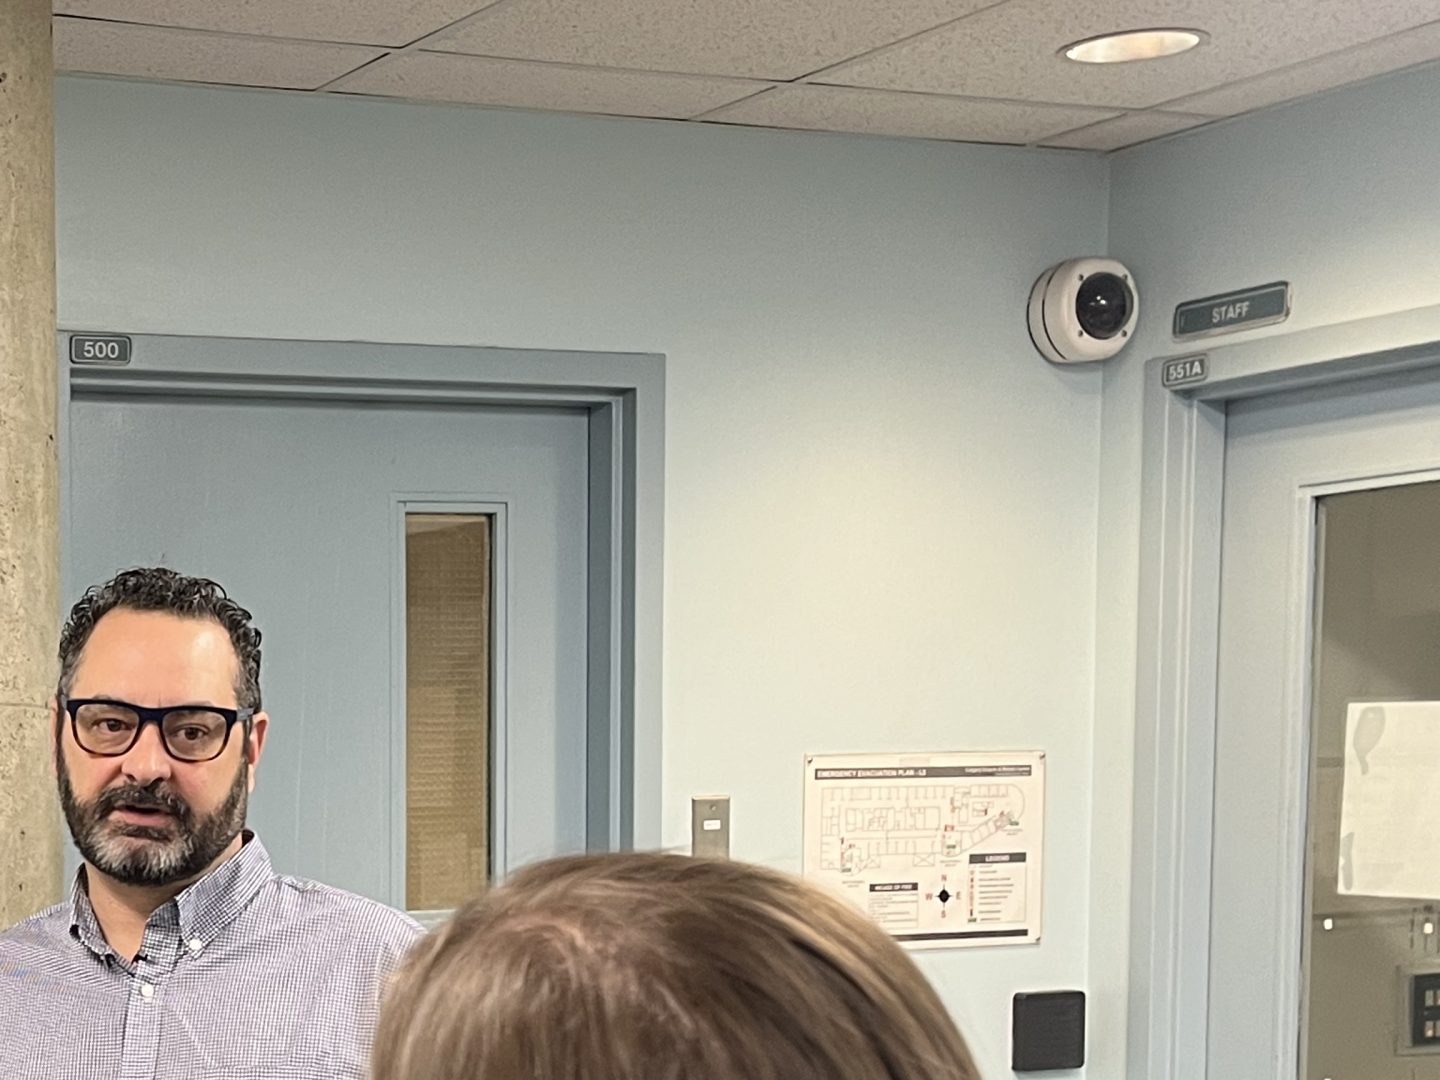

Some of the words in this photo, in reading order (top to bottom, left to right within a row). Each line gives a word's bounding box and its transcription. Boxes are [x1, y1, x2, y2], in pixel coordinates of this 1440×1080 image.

[1211, 301, 1250, 323] STAFF
[83, 341, 119, 358] 500
[1168, 361, 1202, 381] 551A
